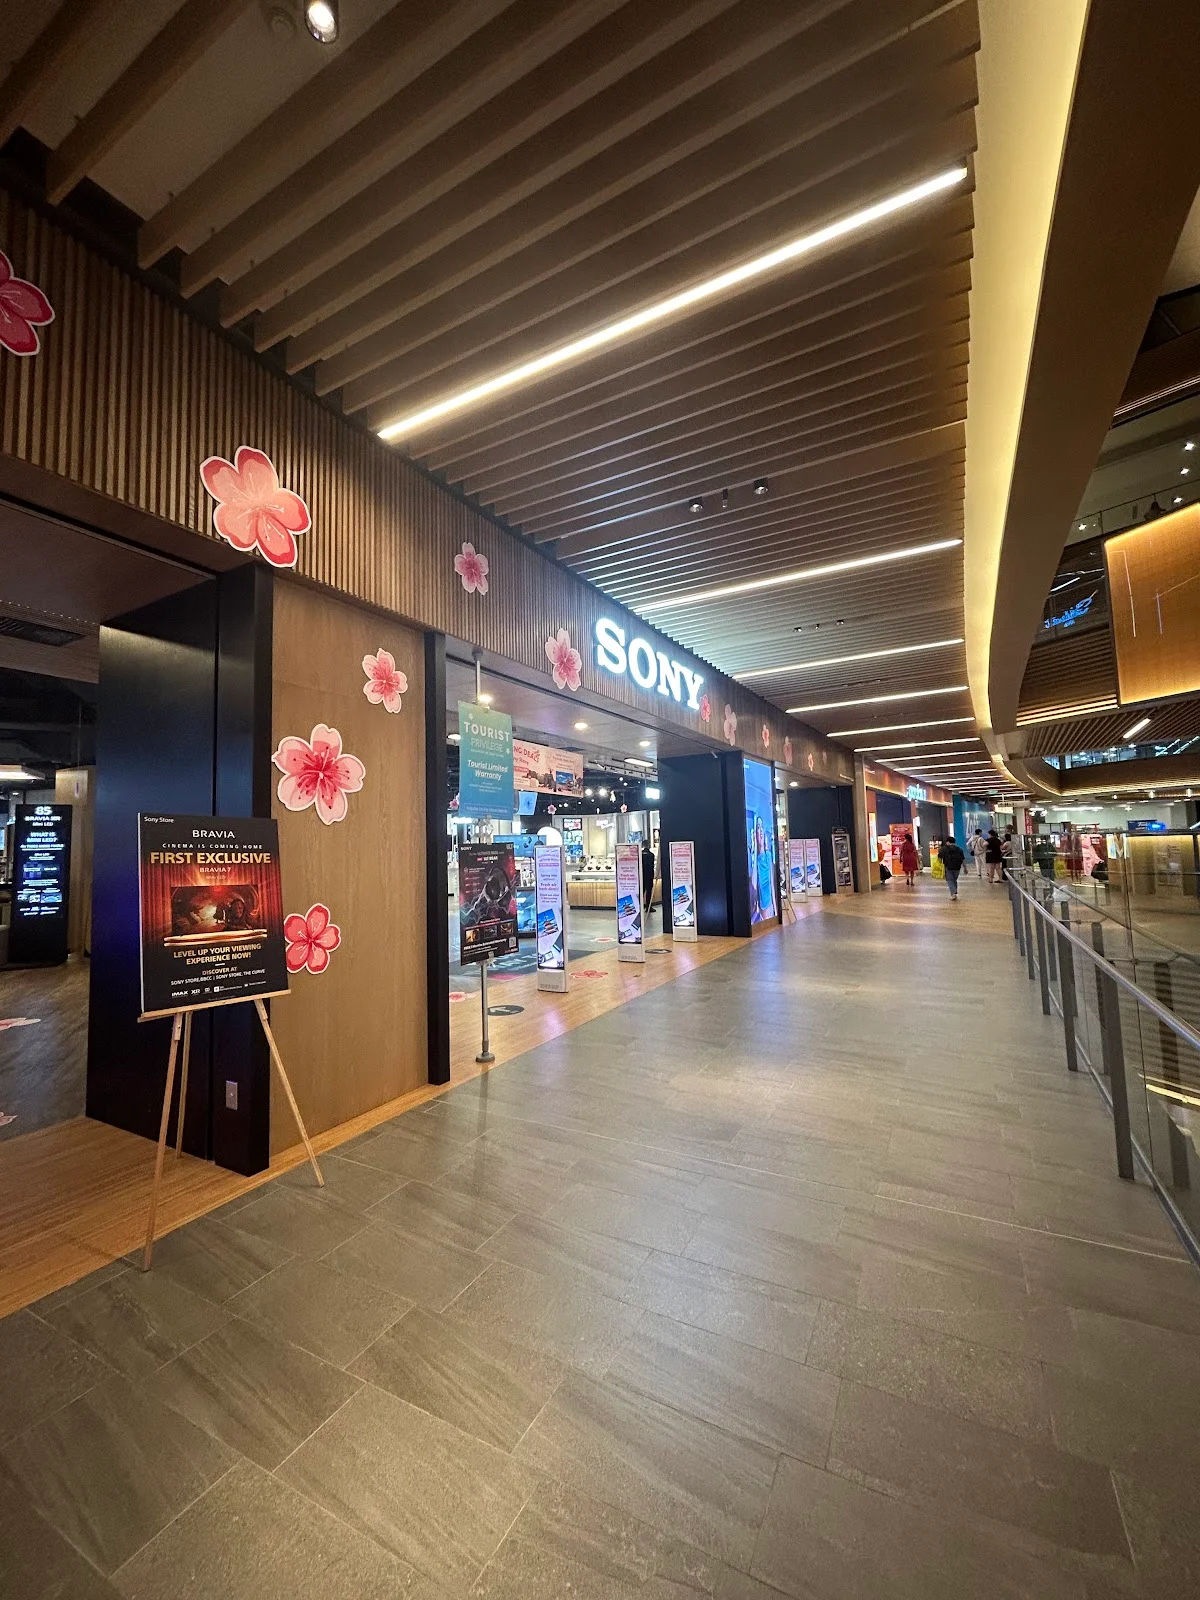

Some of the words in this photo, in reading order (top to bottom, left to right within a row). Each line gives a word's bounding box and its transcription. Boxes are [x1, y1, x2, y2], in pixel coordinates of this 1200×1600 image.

[596, 618, 704, 710] SONY
[464, 722, 510, 742] TOURIST
[470, 738, 504, 752] PRIVILEGE
[468, 759, 488, 769] Tourist
[488, 763, 508, 773] Limited
[475, 770, 502, 781] Warranty
[192, 830, 236, 838] BRAVIA
[150, 852, 193, 864] FIRST
[197, 853, 271, 864] EXCLUSIVE
[174, 950, 196, 958] LEVEL
[231, 943, 261, 952] VIEWING
[186, 954, 230, 965] EXPERIENCE
[202, 967, 230, 975] DISCOVER
